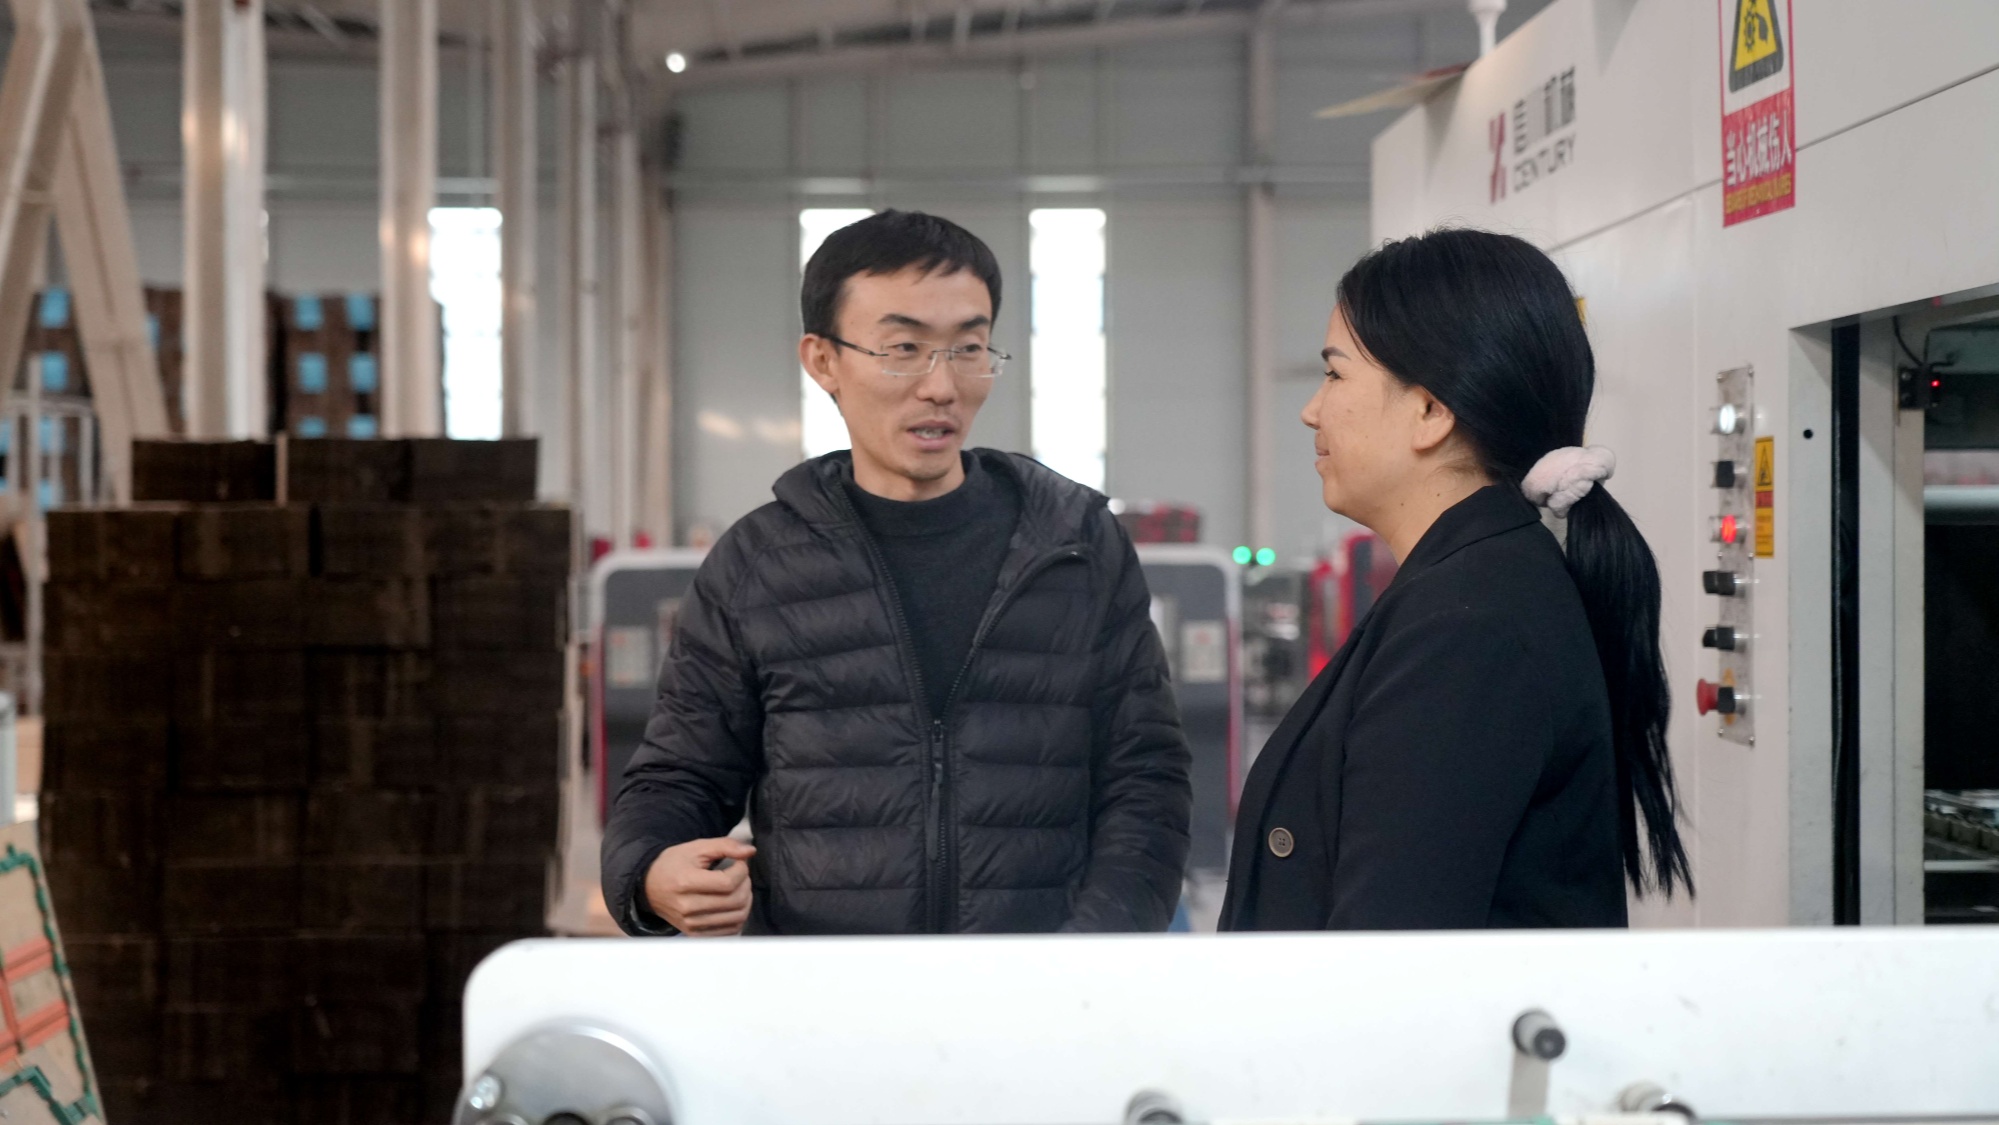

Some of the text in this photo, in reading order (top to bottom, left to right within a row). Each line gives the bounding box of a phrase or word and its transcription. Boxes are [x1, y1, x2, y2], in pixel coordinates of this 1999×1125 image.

[1514, 132, 1576, 192] CENTURY
[1726, 109, 1792, 187] 当心机械伤人
